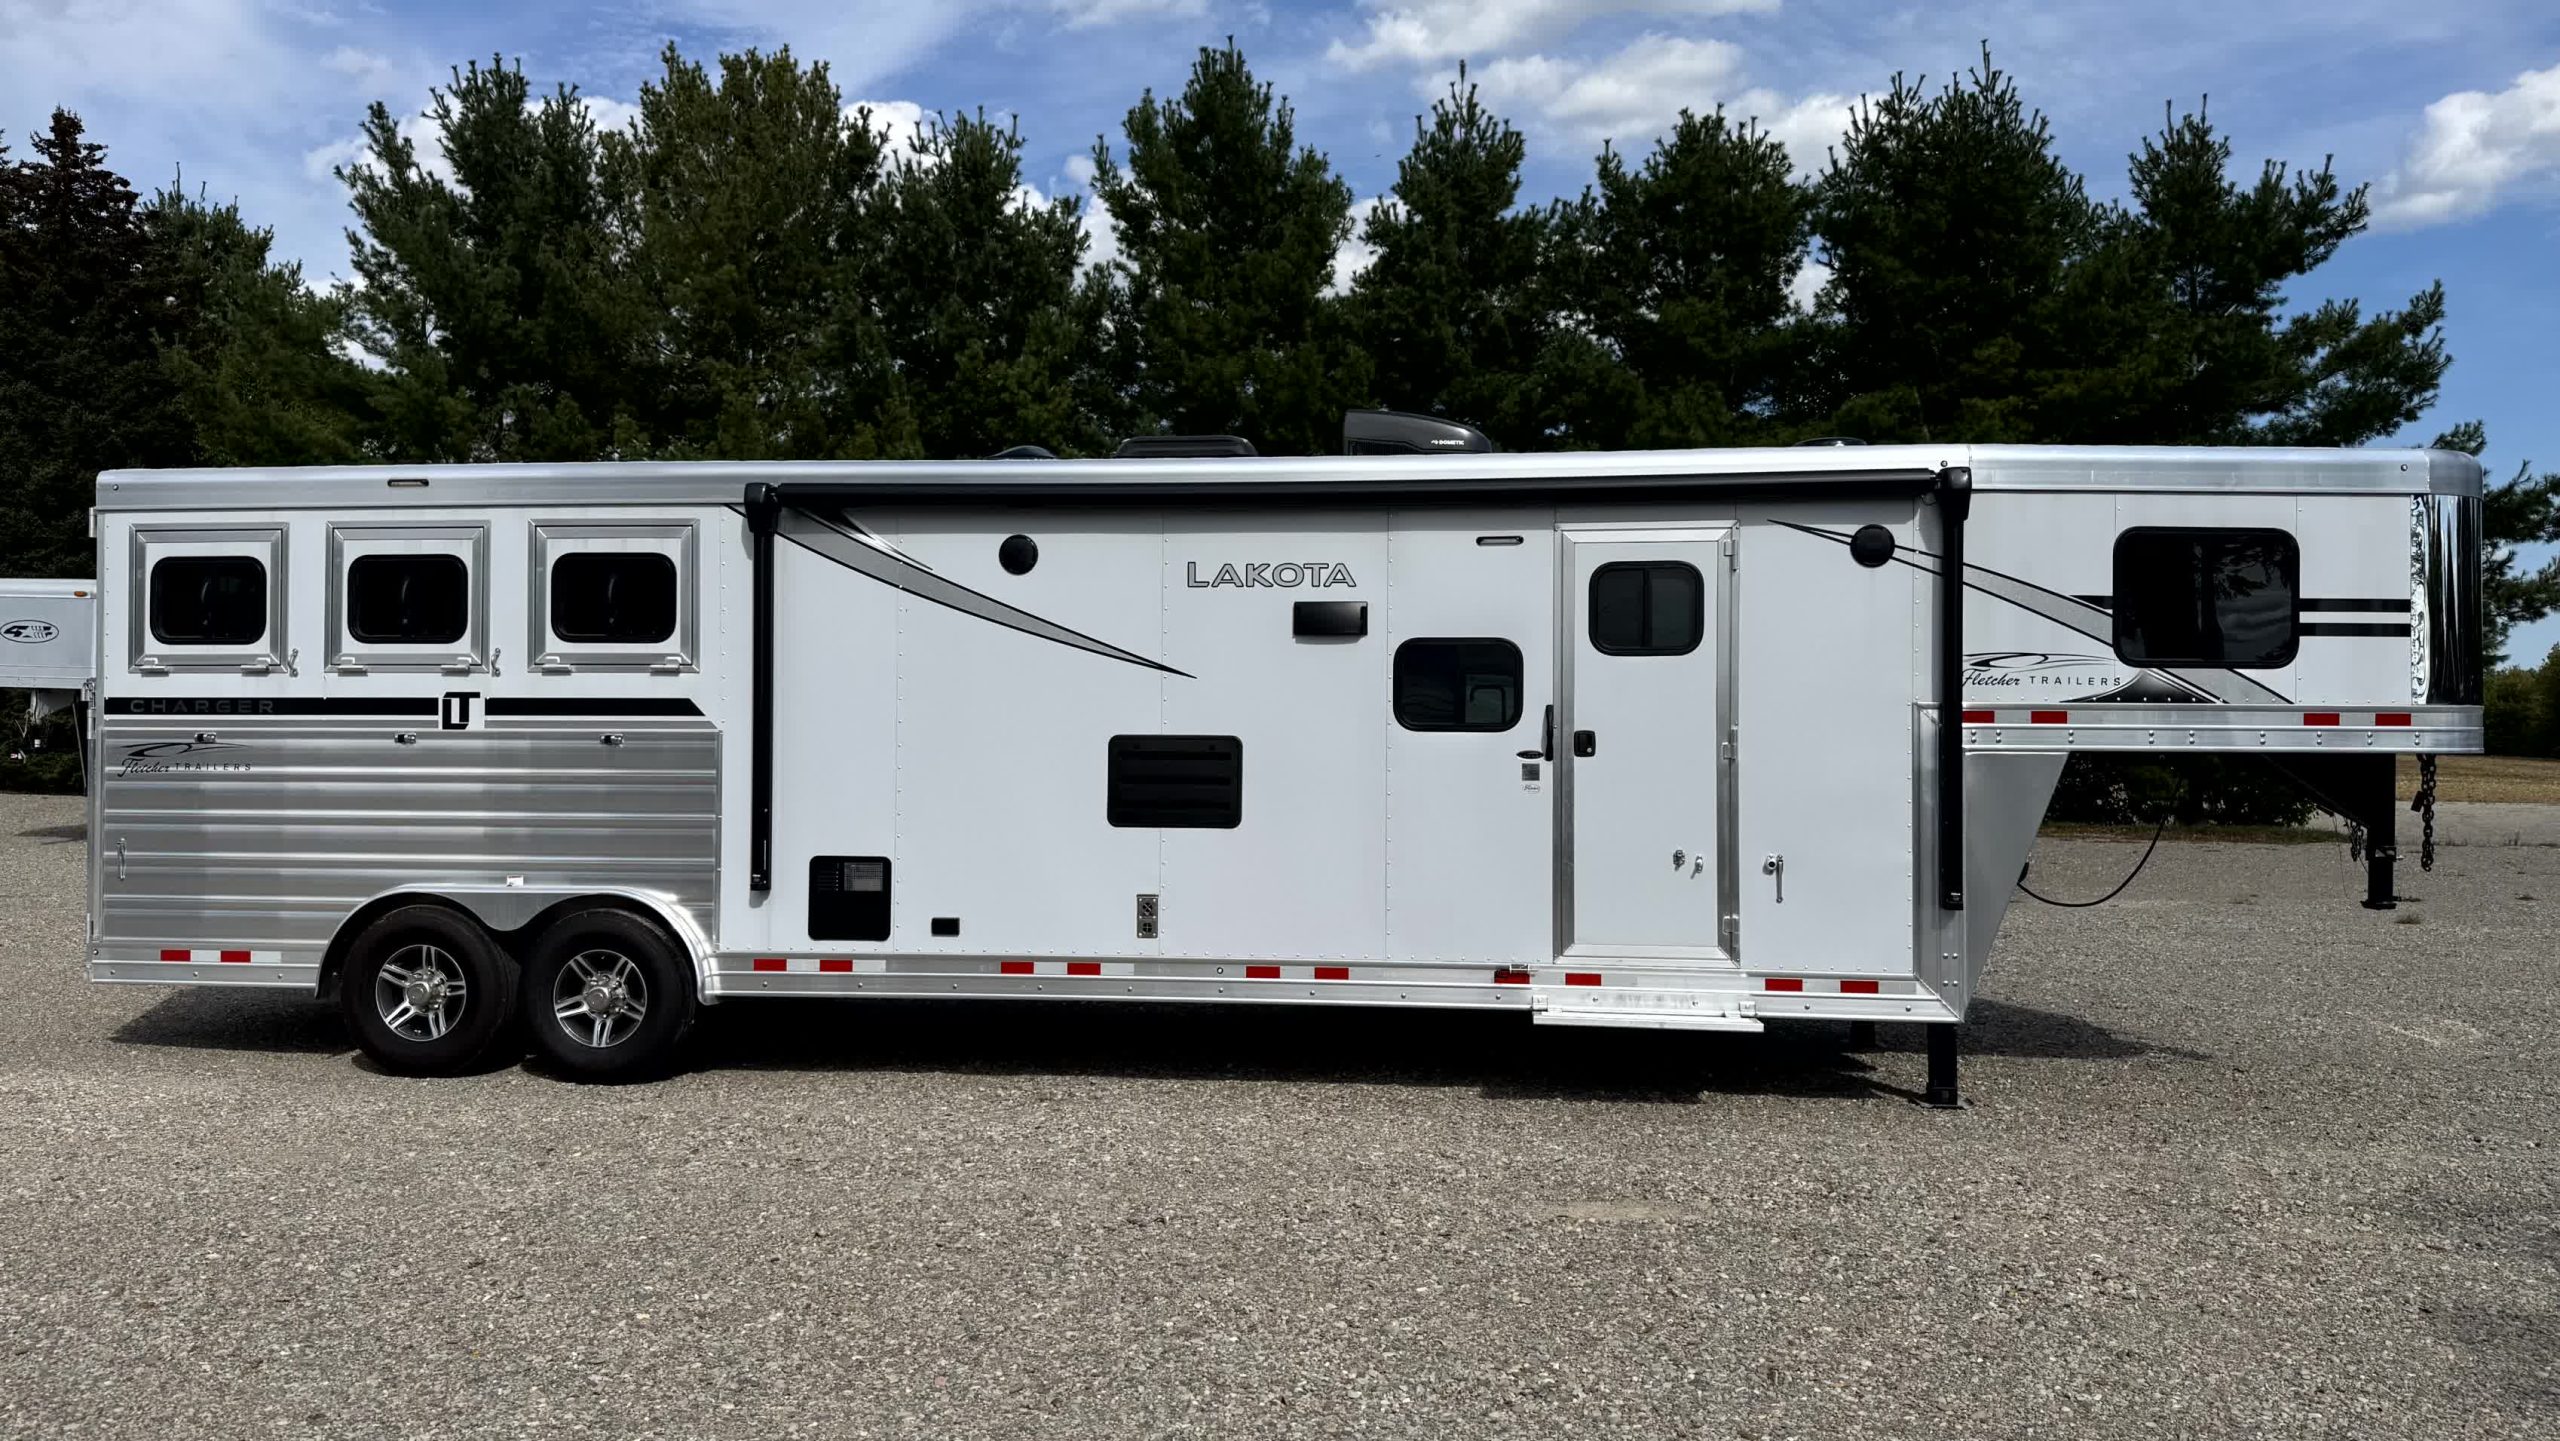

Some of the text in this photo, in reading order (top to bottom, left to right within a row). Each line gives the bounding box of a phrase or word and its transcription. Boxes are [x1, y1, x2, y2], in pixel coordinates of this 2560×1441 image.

[1187, 561, 1357, 588] LAKOTA
[1962, 668, 2121, 687] Fletcher TRAILERS
[130, 699, 274, 713] CHARGER
[117, 757, 251, 778] Fletcher TRAILERS
